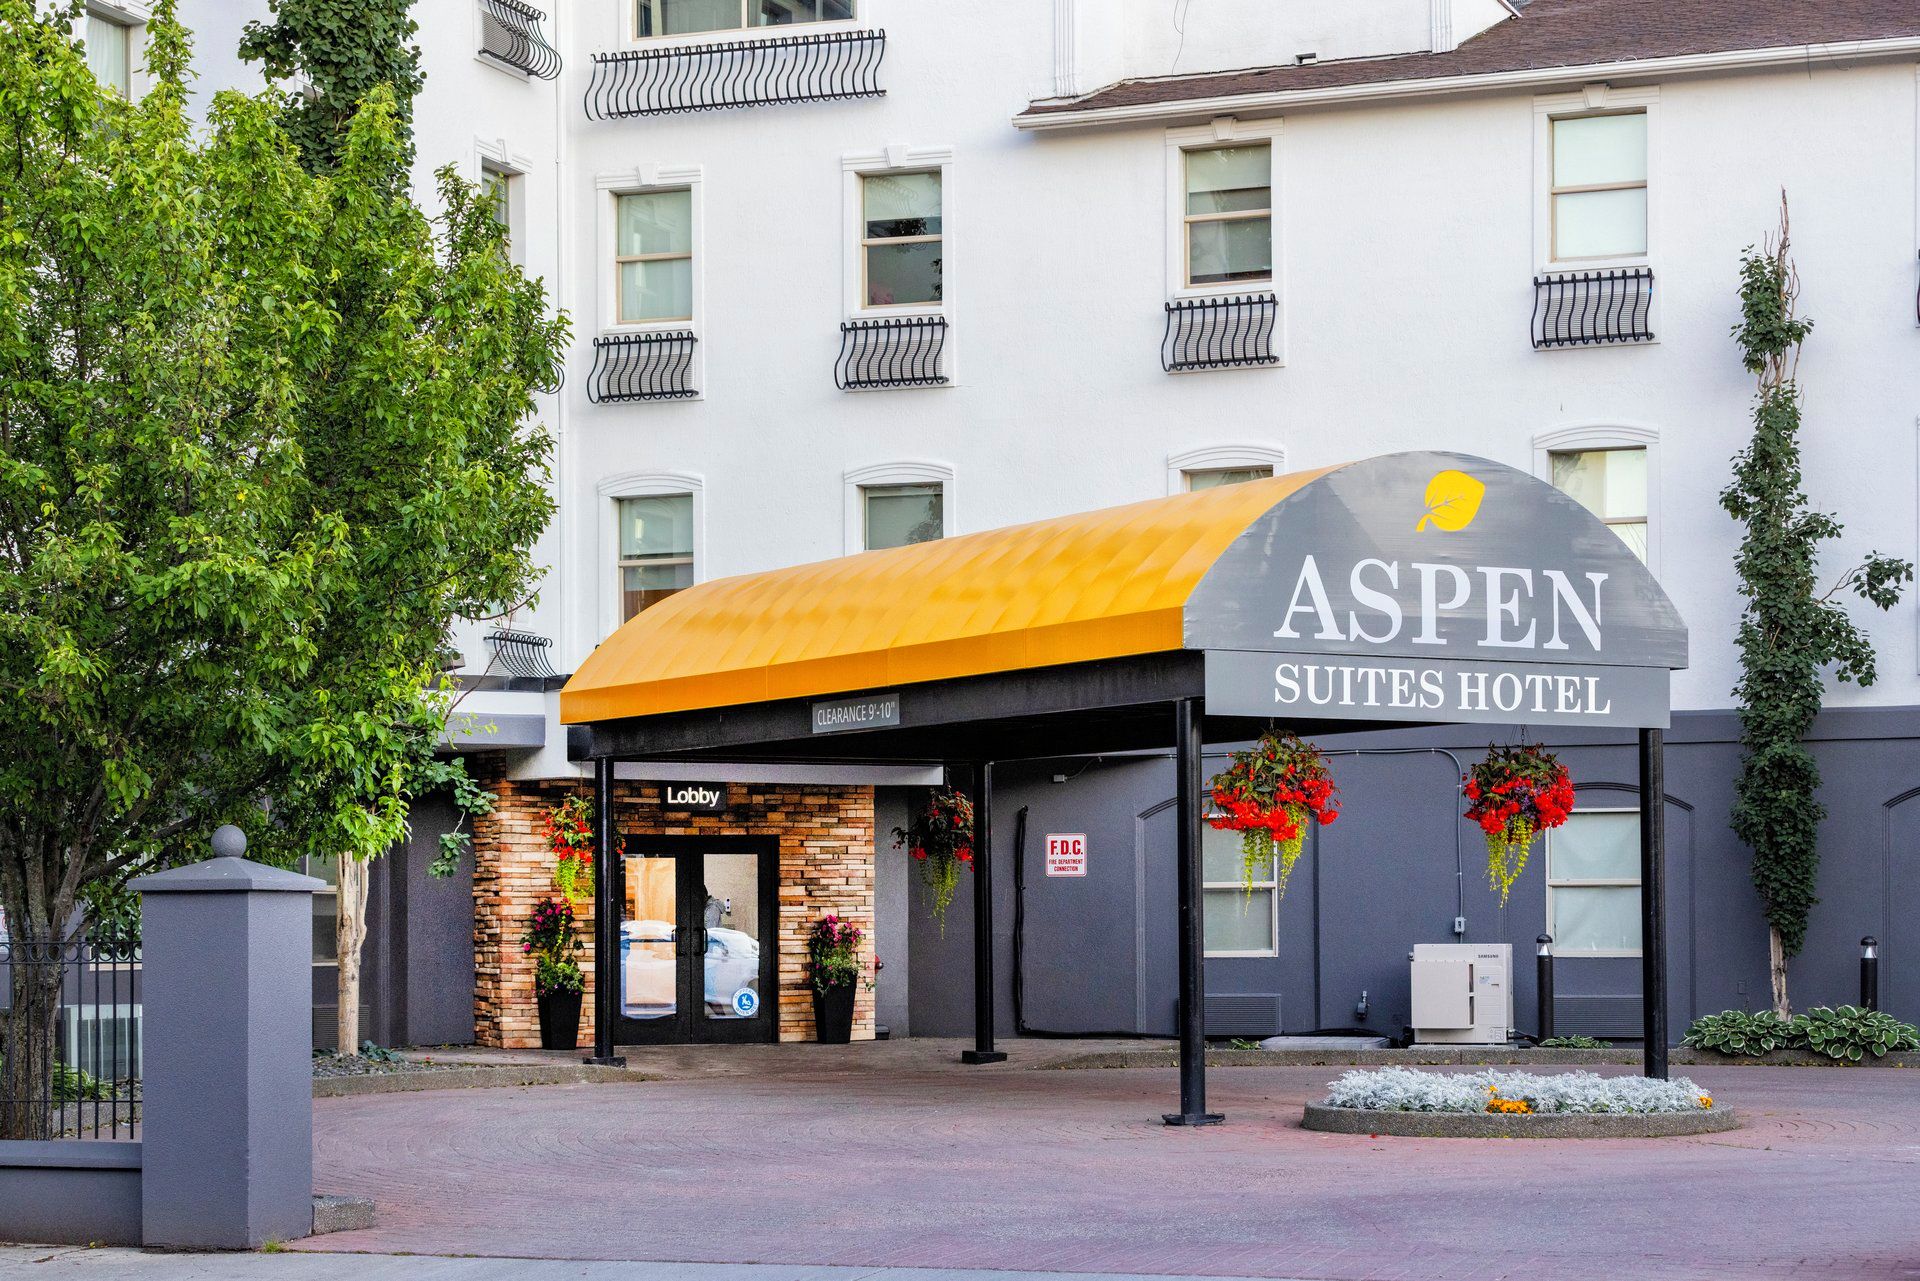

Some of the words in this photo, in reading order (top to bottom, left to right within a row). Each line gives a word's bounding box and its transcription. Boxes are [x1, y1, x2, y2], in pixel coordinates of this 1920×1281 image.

[1273, 554, 1609, 651] ASPEN
[1274, 663, 1445, 709] SUITES
[1458, 672, 1611, 714] HOTEL
[817, 705, 866, 725] CLEARANCE
[868, 702, 895, 720] 9'-10"
[667, 786, 720, 807] Lobby
[1050, 840, 1083, 855] F.D.C.
